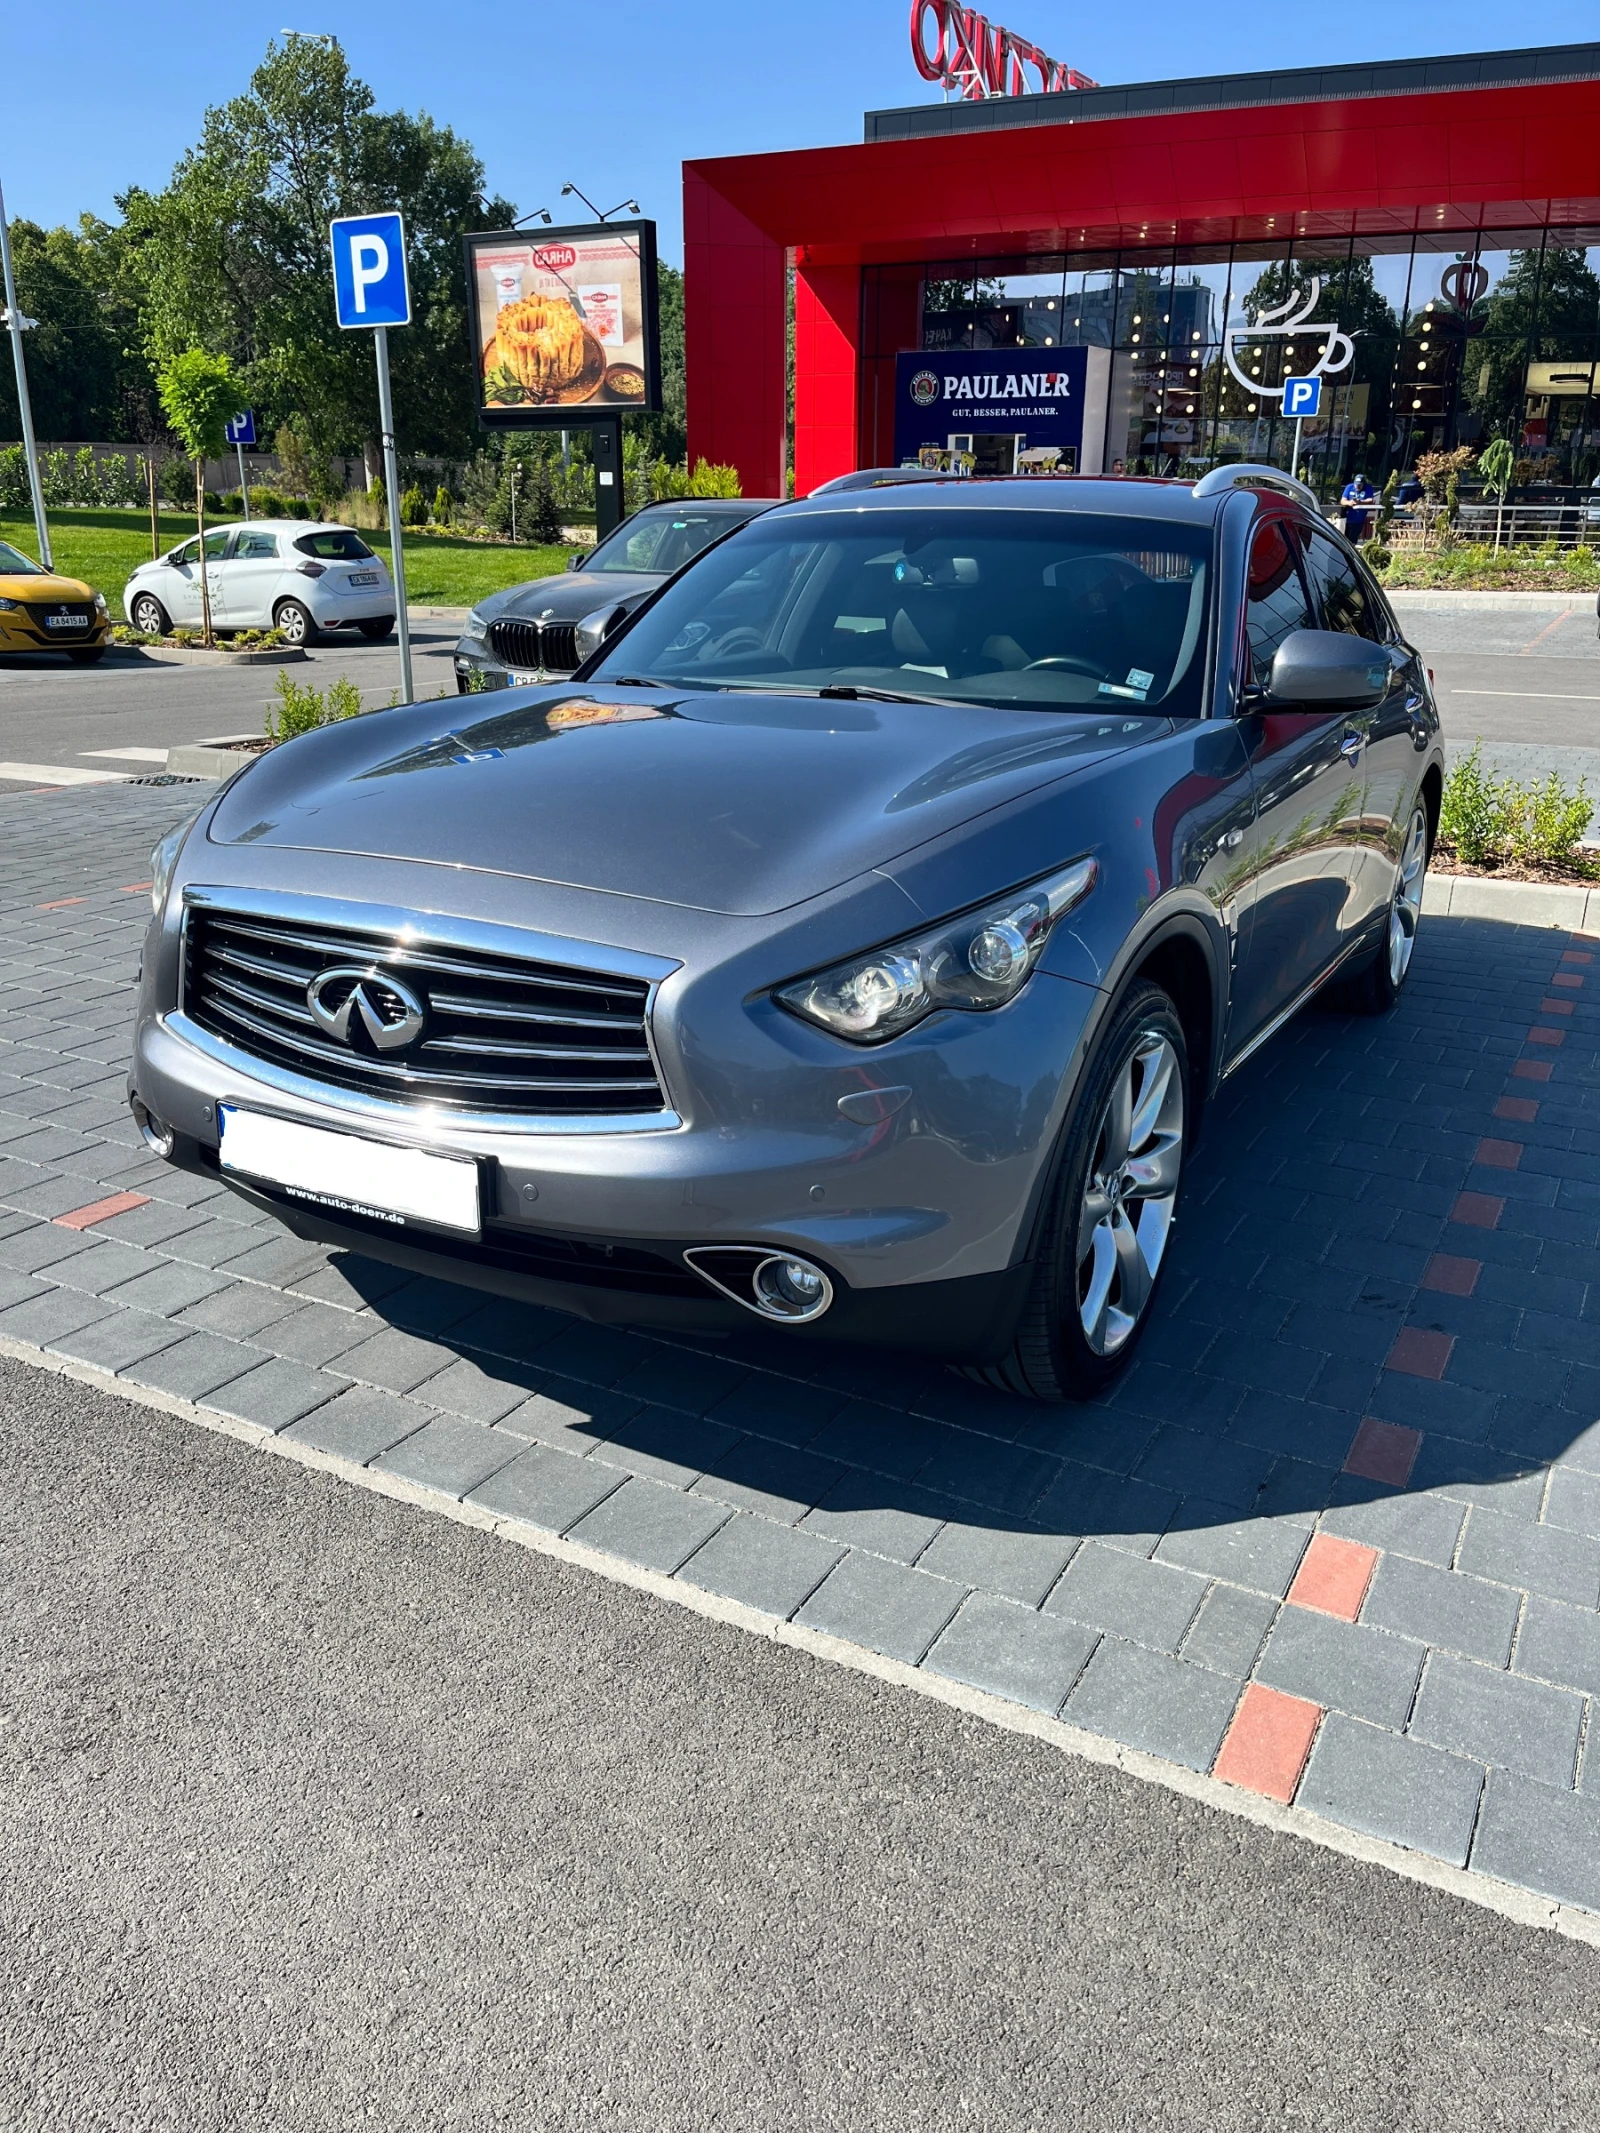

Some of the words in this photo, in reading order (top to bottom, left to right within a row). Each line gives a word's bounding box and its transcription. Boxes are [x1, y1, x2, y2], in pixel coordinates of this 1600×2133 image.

[535, 250, 573, 266] САЯНА
[350, 234, 389, 313] P
[943, 373, 1070, 399] PAULANER
[1291, 383, 1312, 412] P
[232, 412, 247, 438] P
[952, 409, 971, 417] GUT,
[973, 408, 1009, 417] BESSER,
[1010, 407, 1058, 416] PAULANER.
[285, 1186, 405, 1224] www.auto-doerr.de
